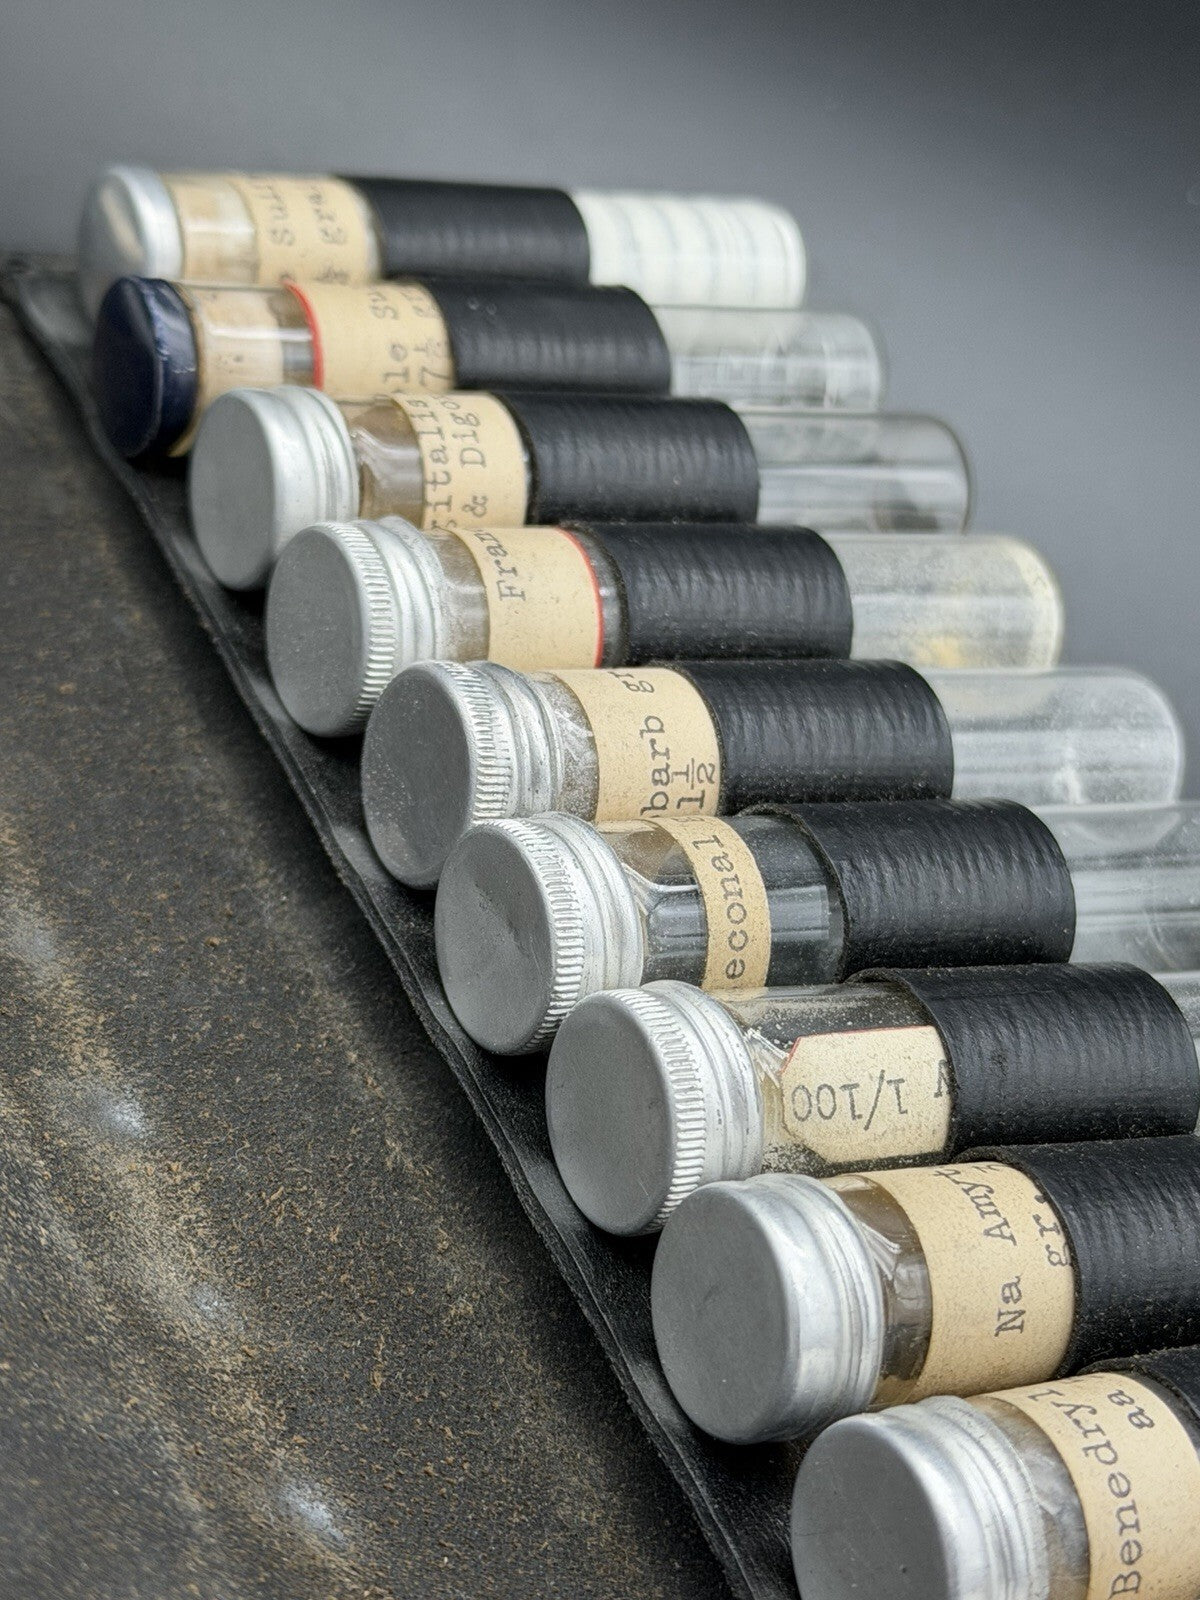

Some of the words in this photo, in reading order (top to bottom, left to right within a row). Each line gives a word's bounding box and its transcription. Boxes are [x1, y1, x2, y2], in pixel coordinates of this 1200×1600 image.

[437, 396, 487, 468] Digo
[462, 495, 488, 518] &
[473, 530, 526, 601] Fran
[608, 671, 656, 693] gr
[639, 715, 671, 817] barb
[691, 834, 749, 981] econal
[791, 1068, 908, 1131] 1/100
[993, 1275, 1027, 1338] Na
[1107, 1389, 1155, 1430] aa
[1027, 1388, 1143, 1600] Benedryl
